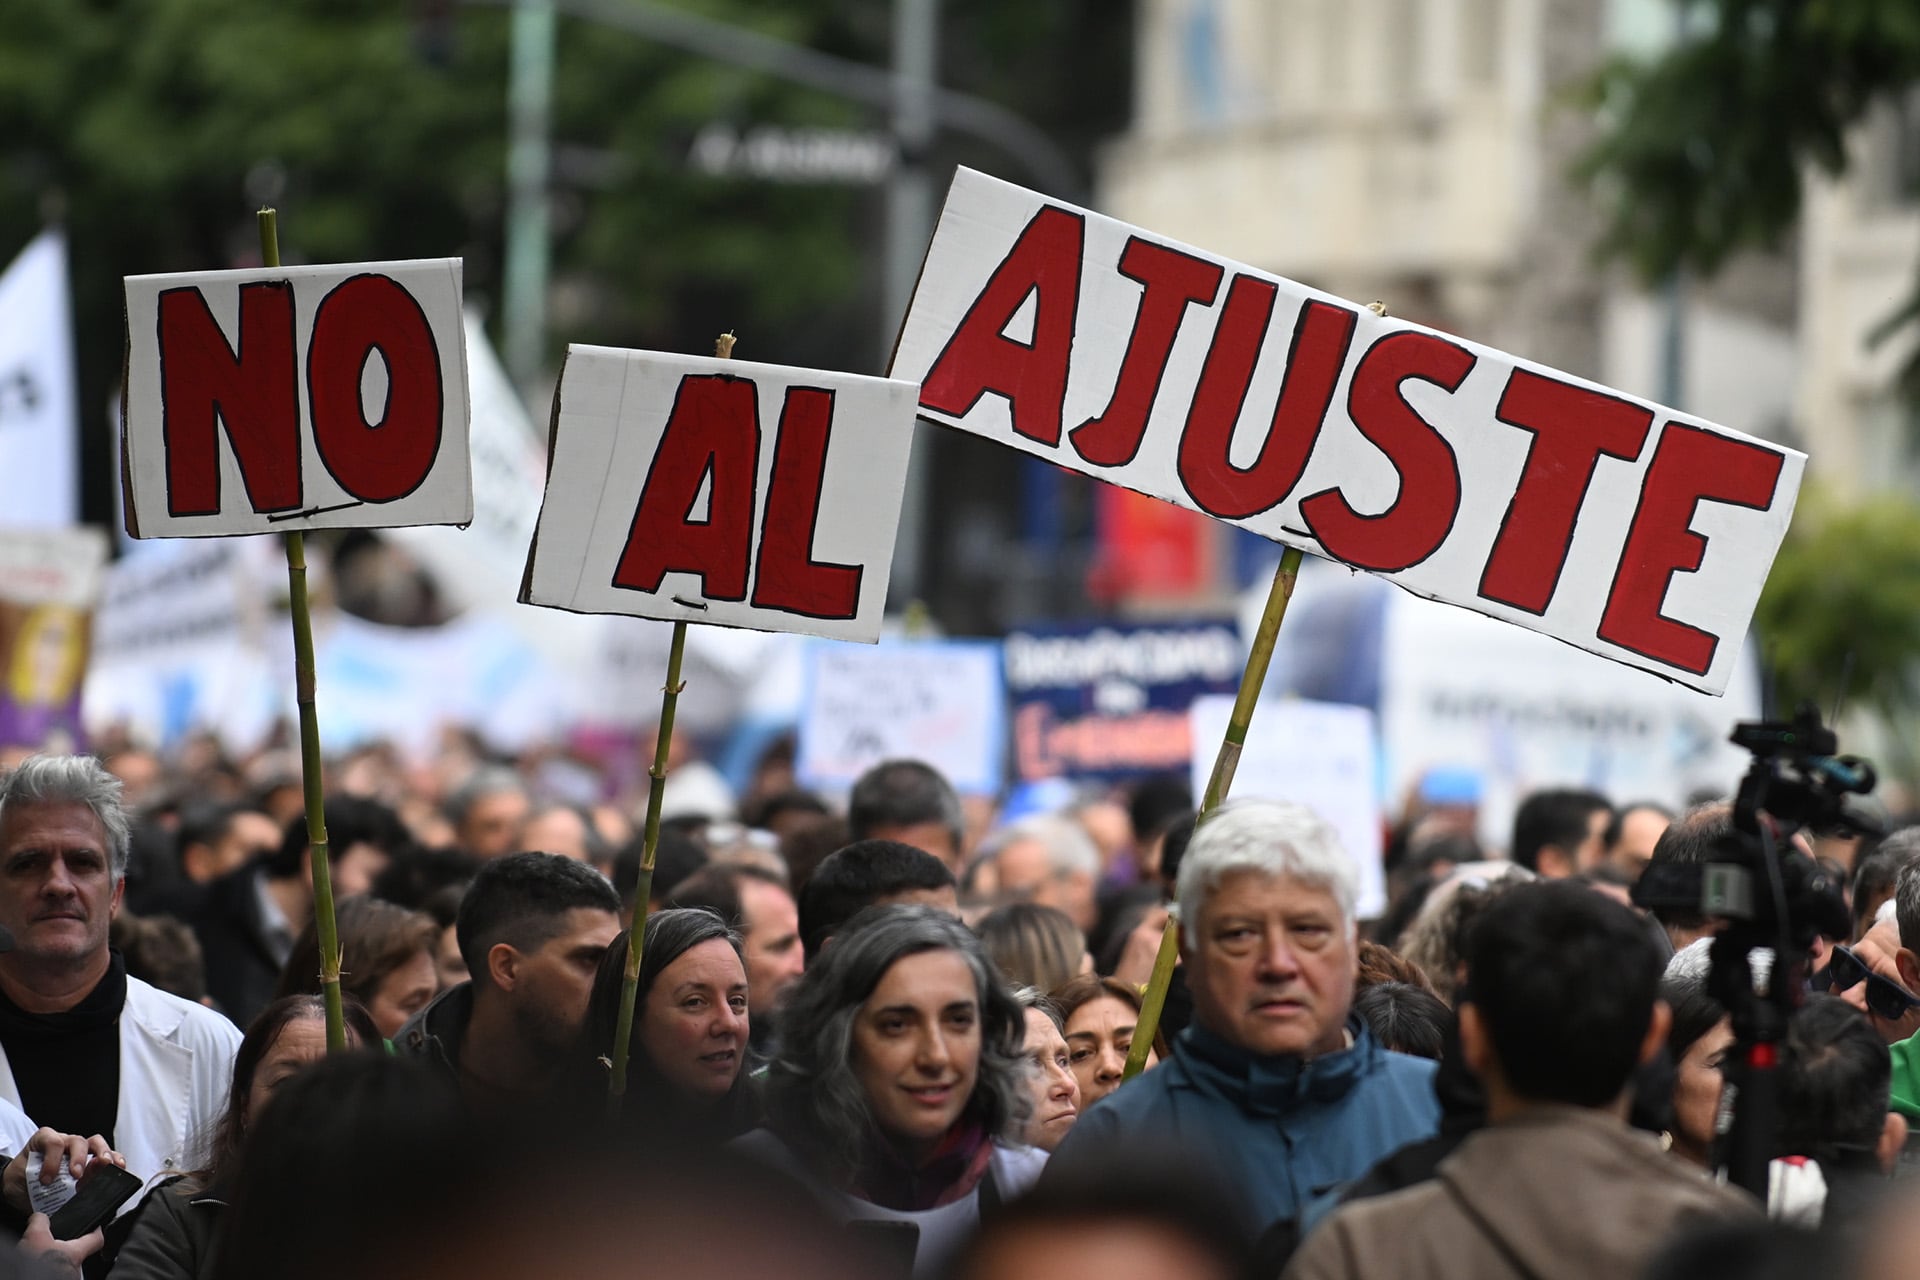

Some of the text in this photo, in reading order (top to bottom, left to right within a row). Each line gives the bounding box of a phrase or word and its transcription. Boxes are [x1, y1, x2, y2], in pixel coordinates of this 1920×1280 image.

[158, 273, 443, 516] NO
[612, 373, 864, 620] AL
[919, 205, 1784, 675] AJUSTE
